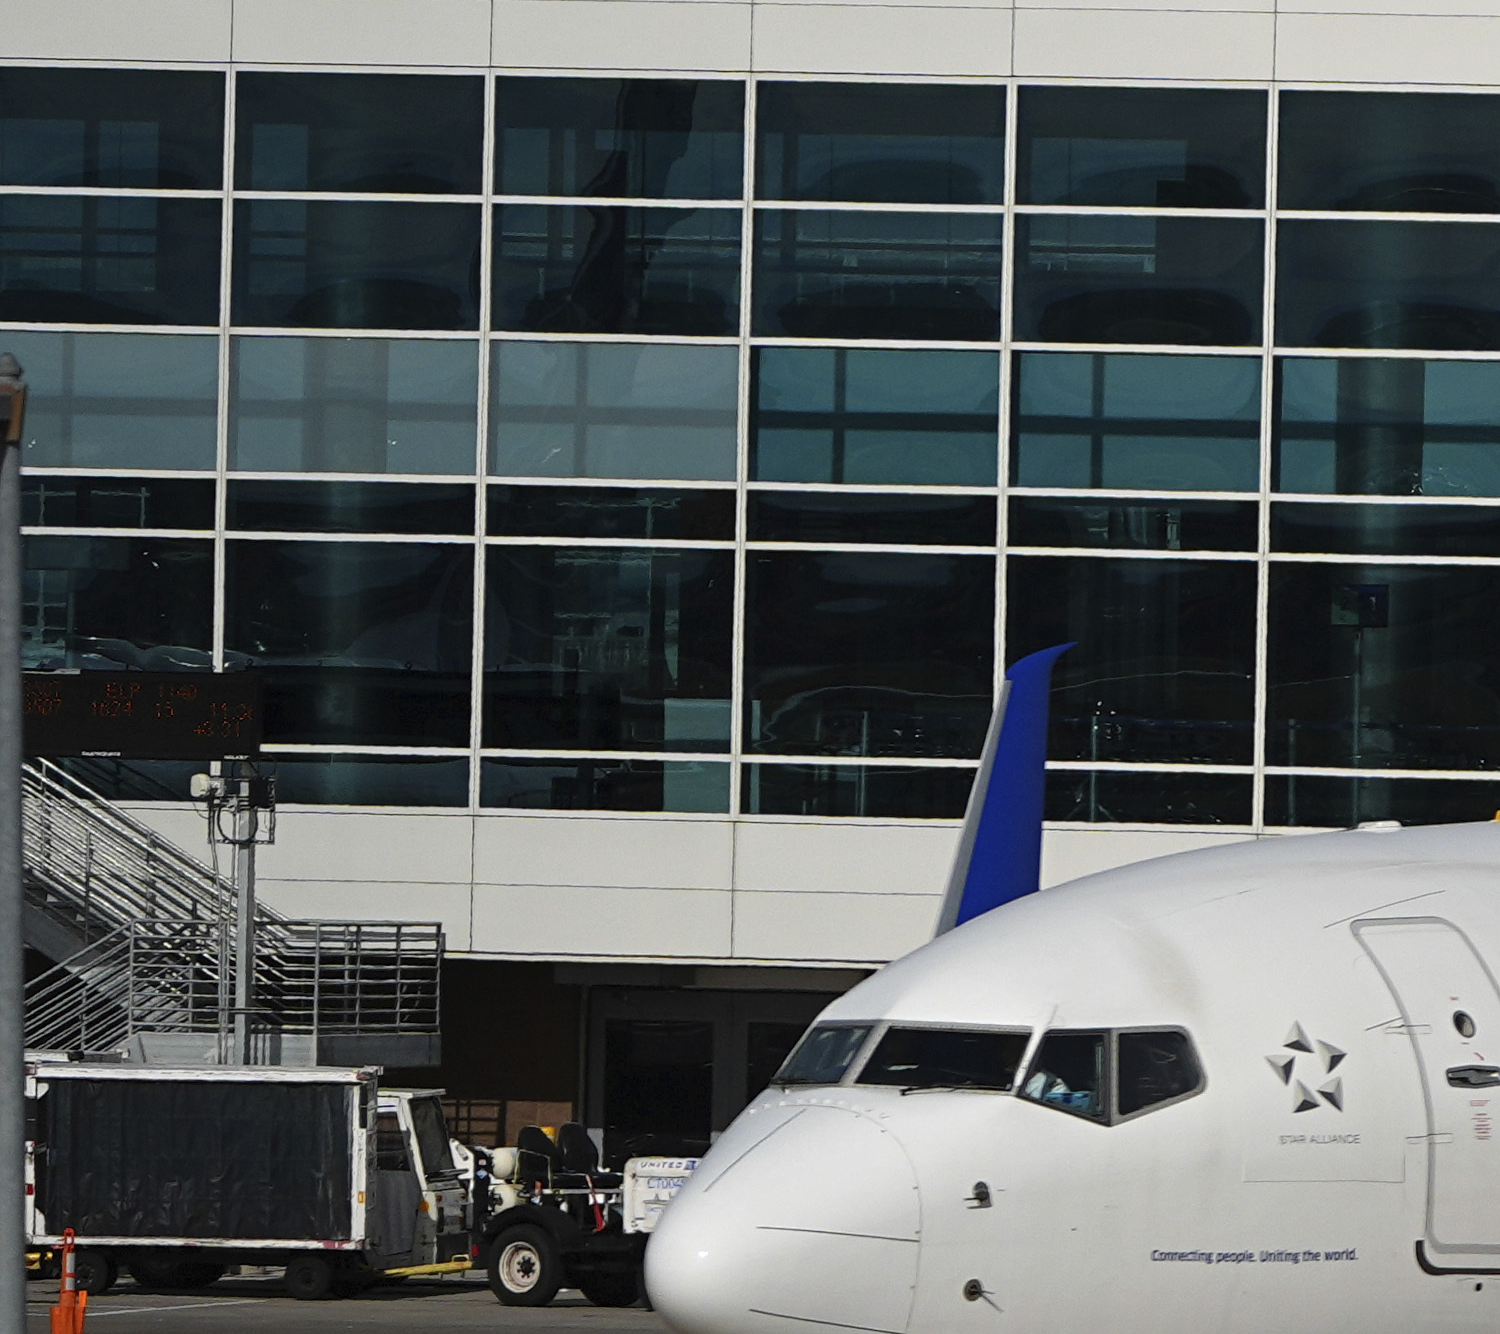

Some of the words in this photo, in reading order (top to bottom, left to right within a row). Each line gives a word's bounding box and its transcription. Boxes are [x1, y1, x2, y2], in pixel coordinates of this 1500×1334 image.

[1279, 1135, 1306, 1144] STAR
[1310, 1134, 1361, 1144] ALLIANCE
[1151, 1249, 1214, 1264] Connecting
[1260, 1250, 1300, 1264] Uniting
[1302, 1250, 1322, 1262] the
[1325, 1248, 1359, 1261] world.
